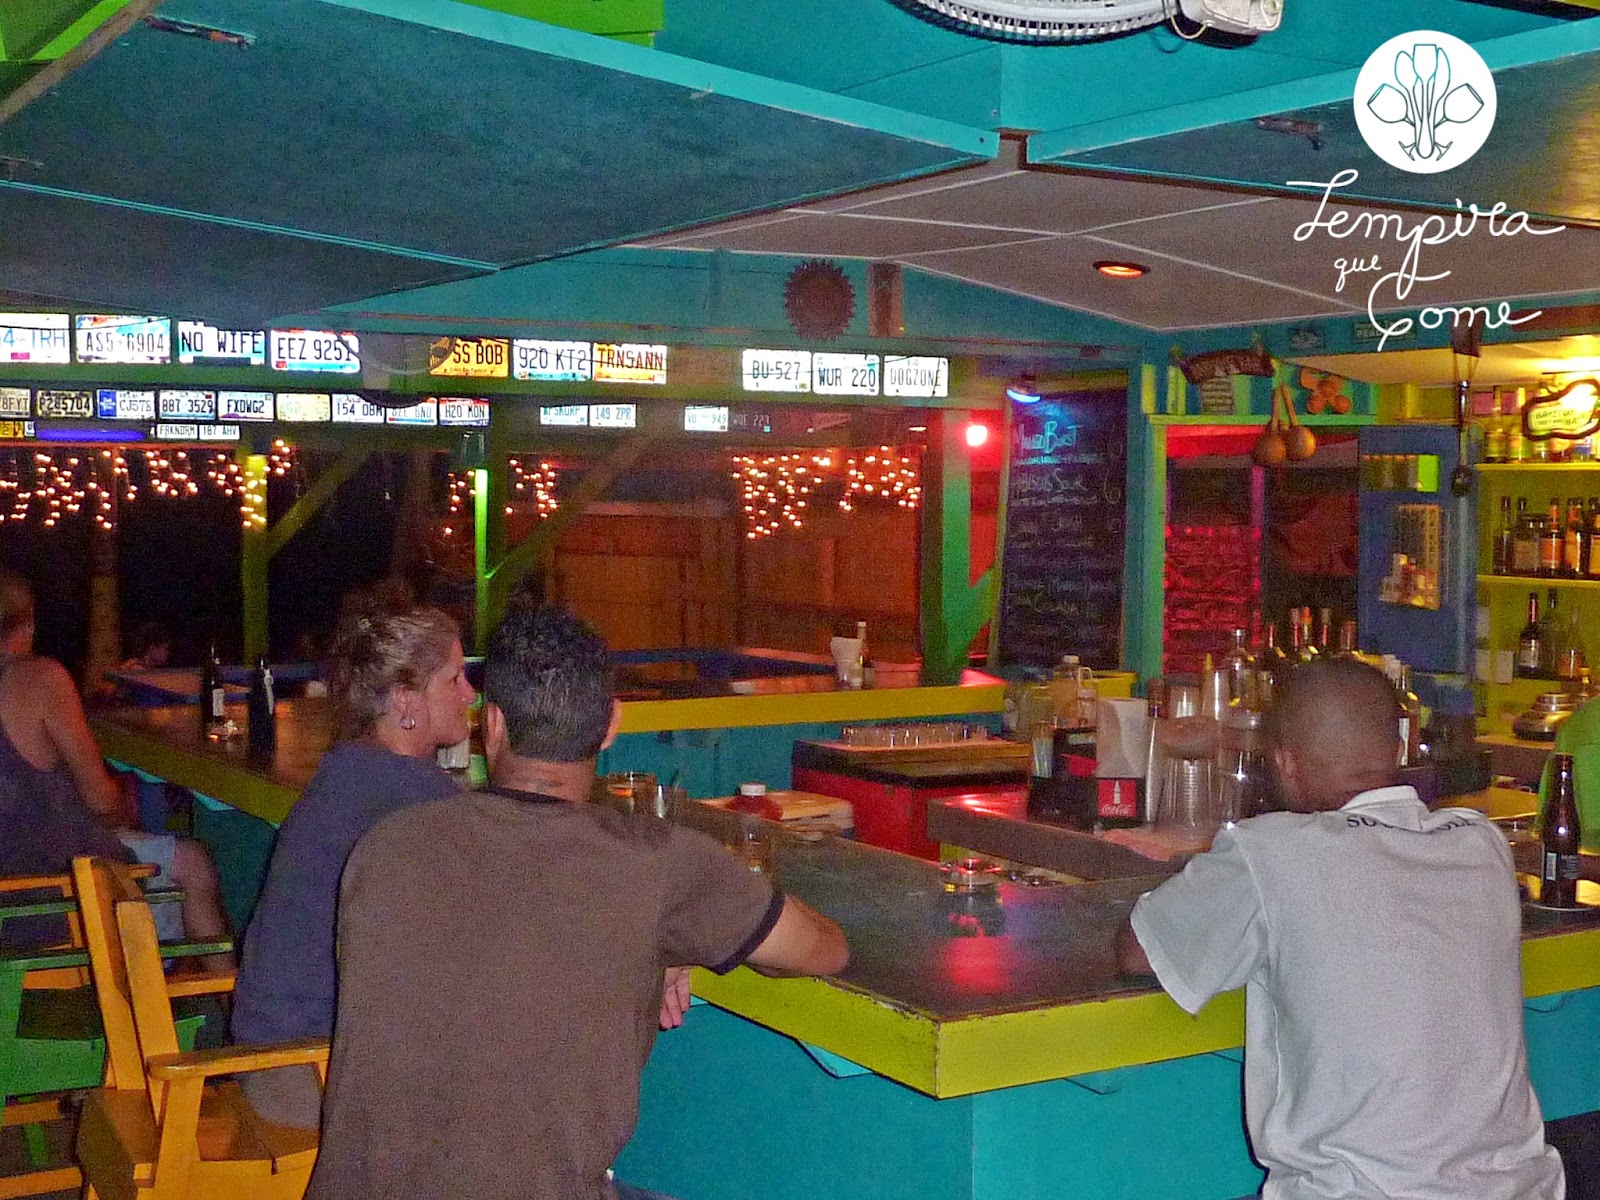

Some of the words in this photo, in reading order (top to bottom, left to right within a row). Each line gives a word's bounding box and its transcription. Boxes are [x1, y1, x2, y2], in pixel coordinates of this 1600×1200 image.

[181, 331, 204, 352] NO
[217, 332, 262, 354] WIFE
[277, 337, 307, 360] EEZ
[475, 343, 503, 366] BOB
[519, 347, 549, 370] 920
[752, 359, 801, 381] BU-527
[818, 367, 843, 387] WUR
[851, 368, 876, 387] 220
[0, 397, 29, 411] 8FYT
[162, 398, 181, 413] 887
[337, 402, 355, 416] 154
